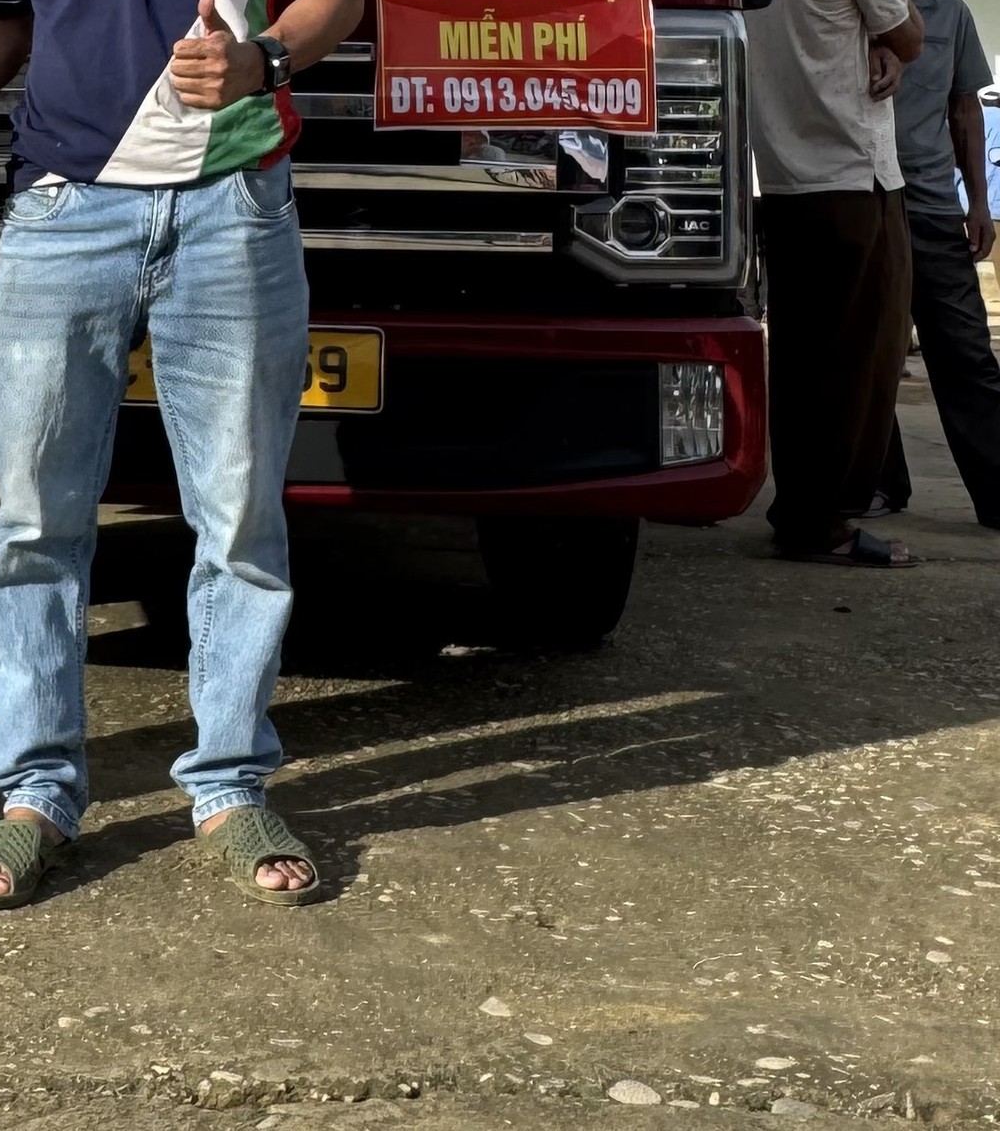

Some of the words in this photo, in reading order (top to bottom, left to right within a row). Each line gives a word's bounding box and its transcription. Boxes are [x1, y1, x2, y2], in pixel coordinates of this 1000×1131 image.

[438, 8, 524, 60] MIỄN
[533, 14, 588, 61] PHÍ
[391, 76, 435, 114] ĐT:
[443, 76, 642, 115] 0913.045.009
[679, 220, 710, 231] JAC
